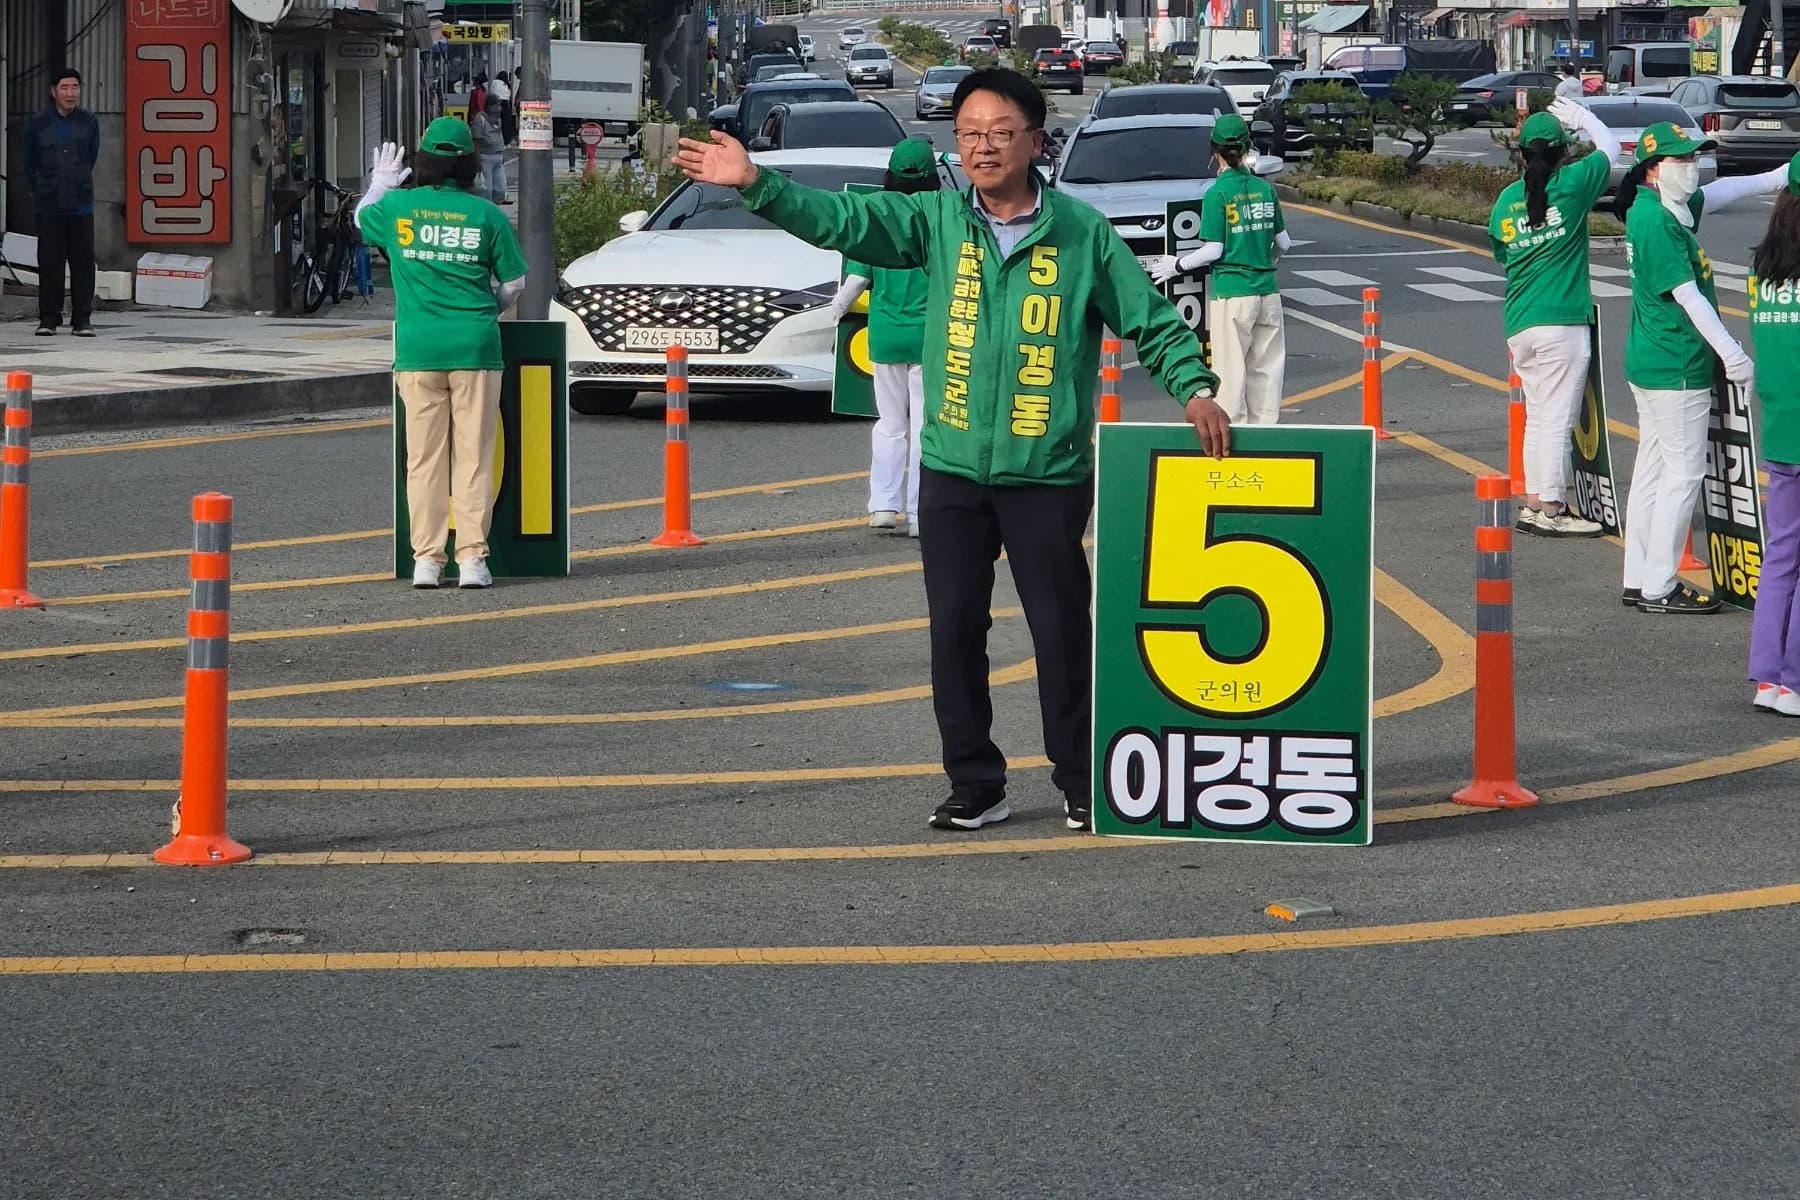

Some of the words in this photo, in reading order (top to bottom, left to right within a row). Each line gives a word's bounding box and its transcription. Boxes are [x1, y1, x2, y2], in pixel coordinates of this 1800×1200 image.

[454, 26, 493, 40] 국화빵
[135, 42, 227, 235] 김밥
[1644, 134, 1658, 153] 5
[1226, 203, 1240, 225] 5
[1243, 202, 1275, 220] 이경동
[397, 218, 415, 246] 5
[420, 225, 481, 250] 이경동
[1500, 217, 1517, 244] 5
[1028, 245, 1060, 287] 5
[1697, 247, 1713, 280] 5
[1747, 276, 1759, 308] 5
[631, 330, 669, 345] 296도
[674, 331, 713, 347] 5553
[1010, 294, 1062, 438] 이경동
[1206, 470, 1265, 491] 무소속
[1575, 469, 1616, 528] 이경동
[1710, 531, 1762, 600] 이경동
[1136, 450, 1332, 720] 5
[1196, 679, 1263, 704] 군의원
[1107, 730, 1360, 831] 이경동
